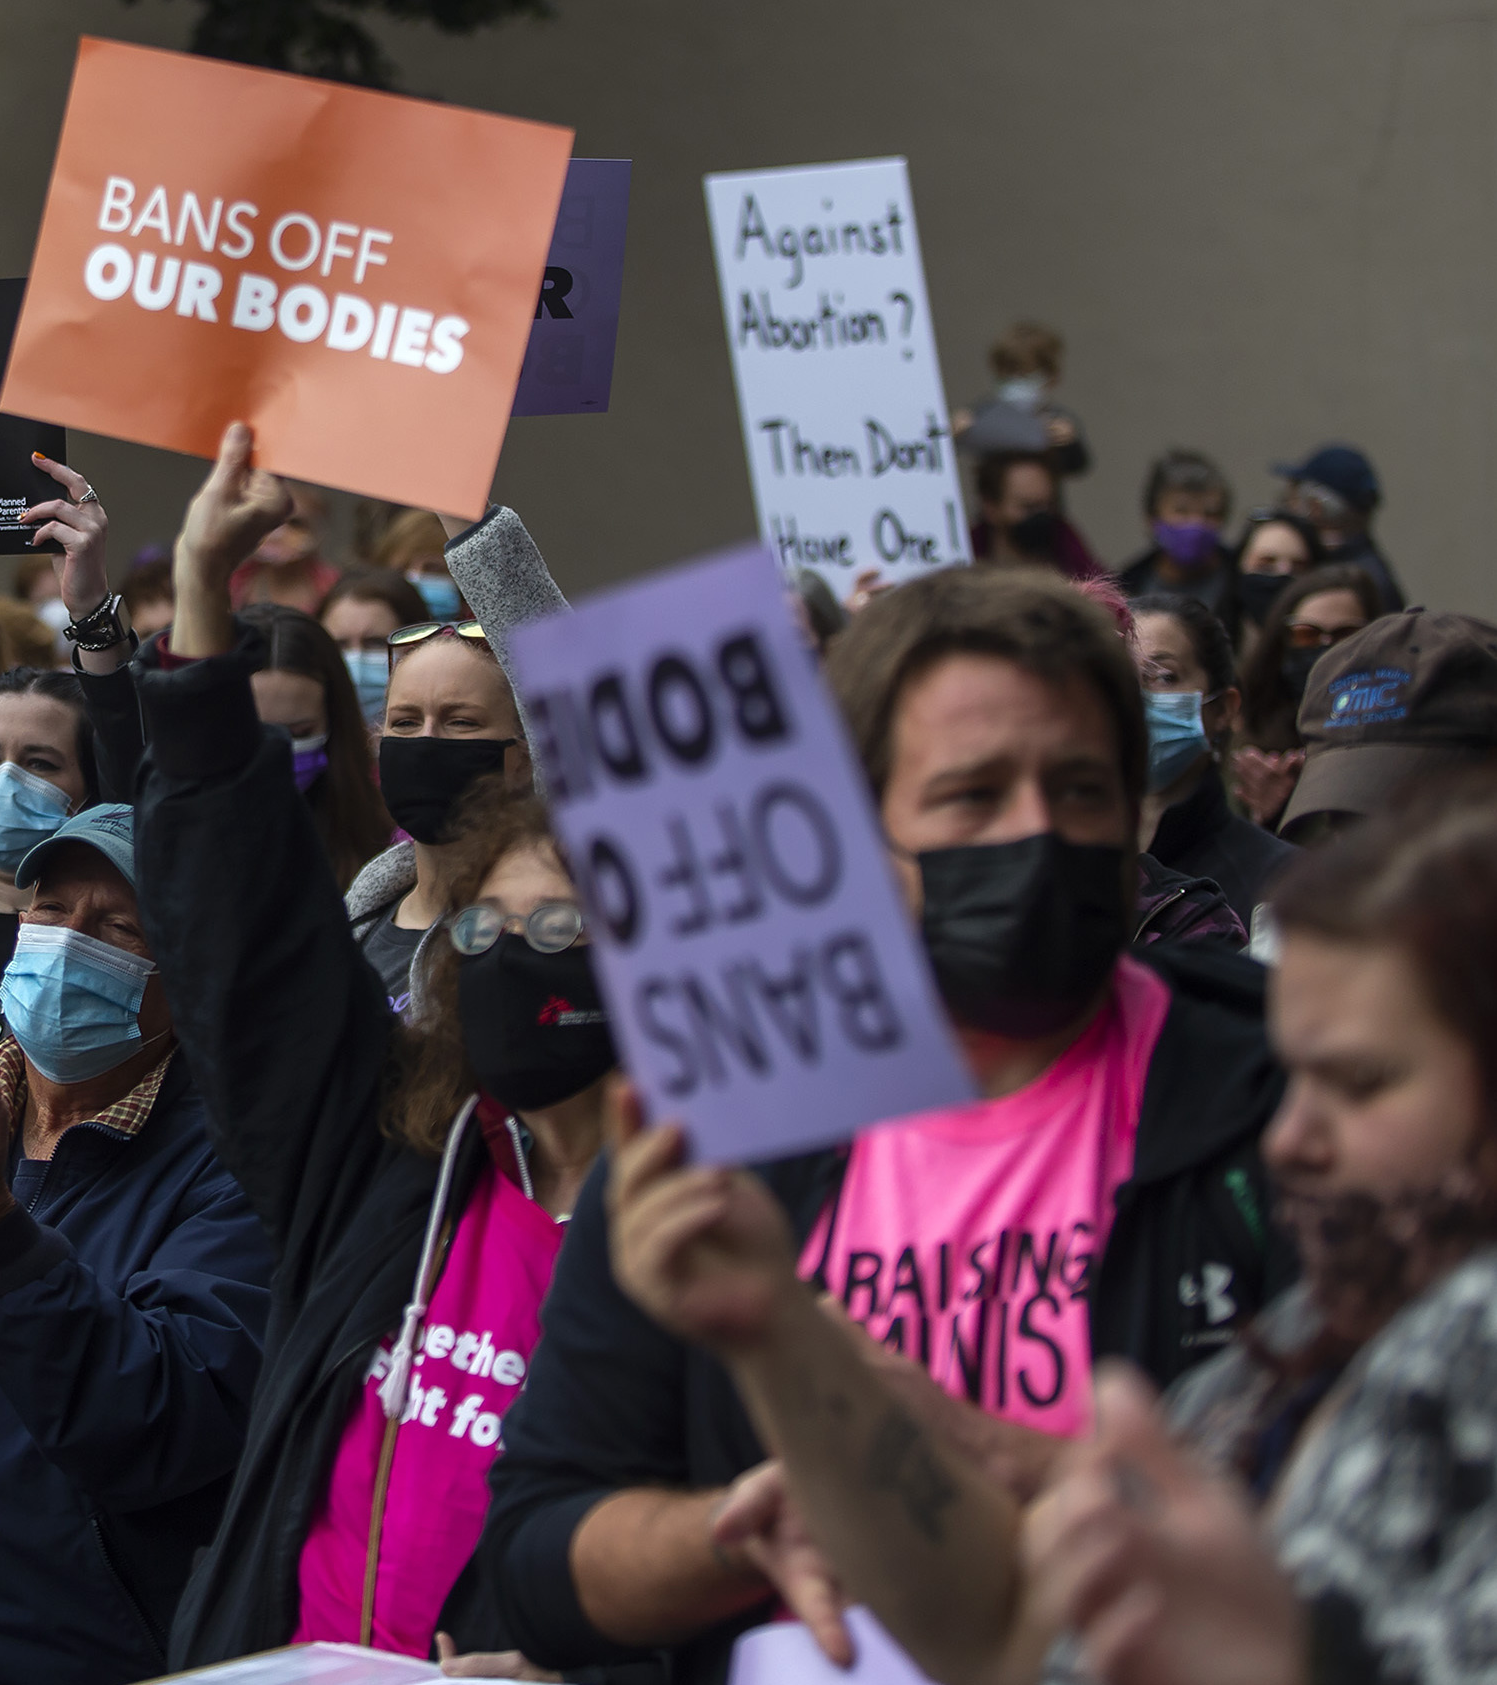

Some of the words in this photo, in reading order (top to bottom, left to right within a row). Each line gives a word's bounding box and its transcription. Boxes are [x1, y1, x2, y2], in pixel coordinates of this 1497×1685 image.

[98, 175, 259, 260] BANS
[269, 212, 394, 285] OFF
[734, 192, 905, 288] Against
[84, 243, 223, 323] OUR
[232, 272, 470, 375] BODIES
[535, 266, 574, 319] R
[758, 416, 861, 478] Then
[769, 512, 855, 568] Have
[654, 779, 845, 939] OFF
[630, 926, 907, 1098] BANS
[417, 1323, 529, 1388] ethe
[448, 1394, 505, 1450] fo
